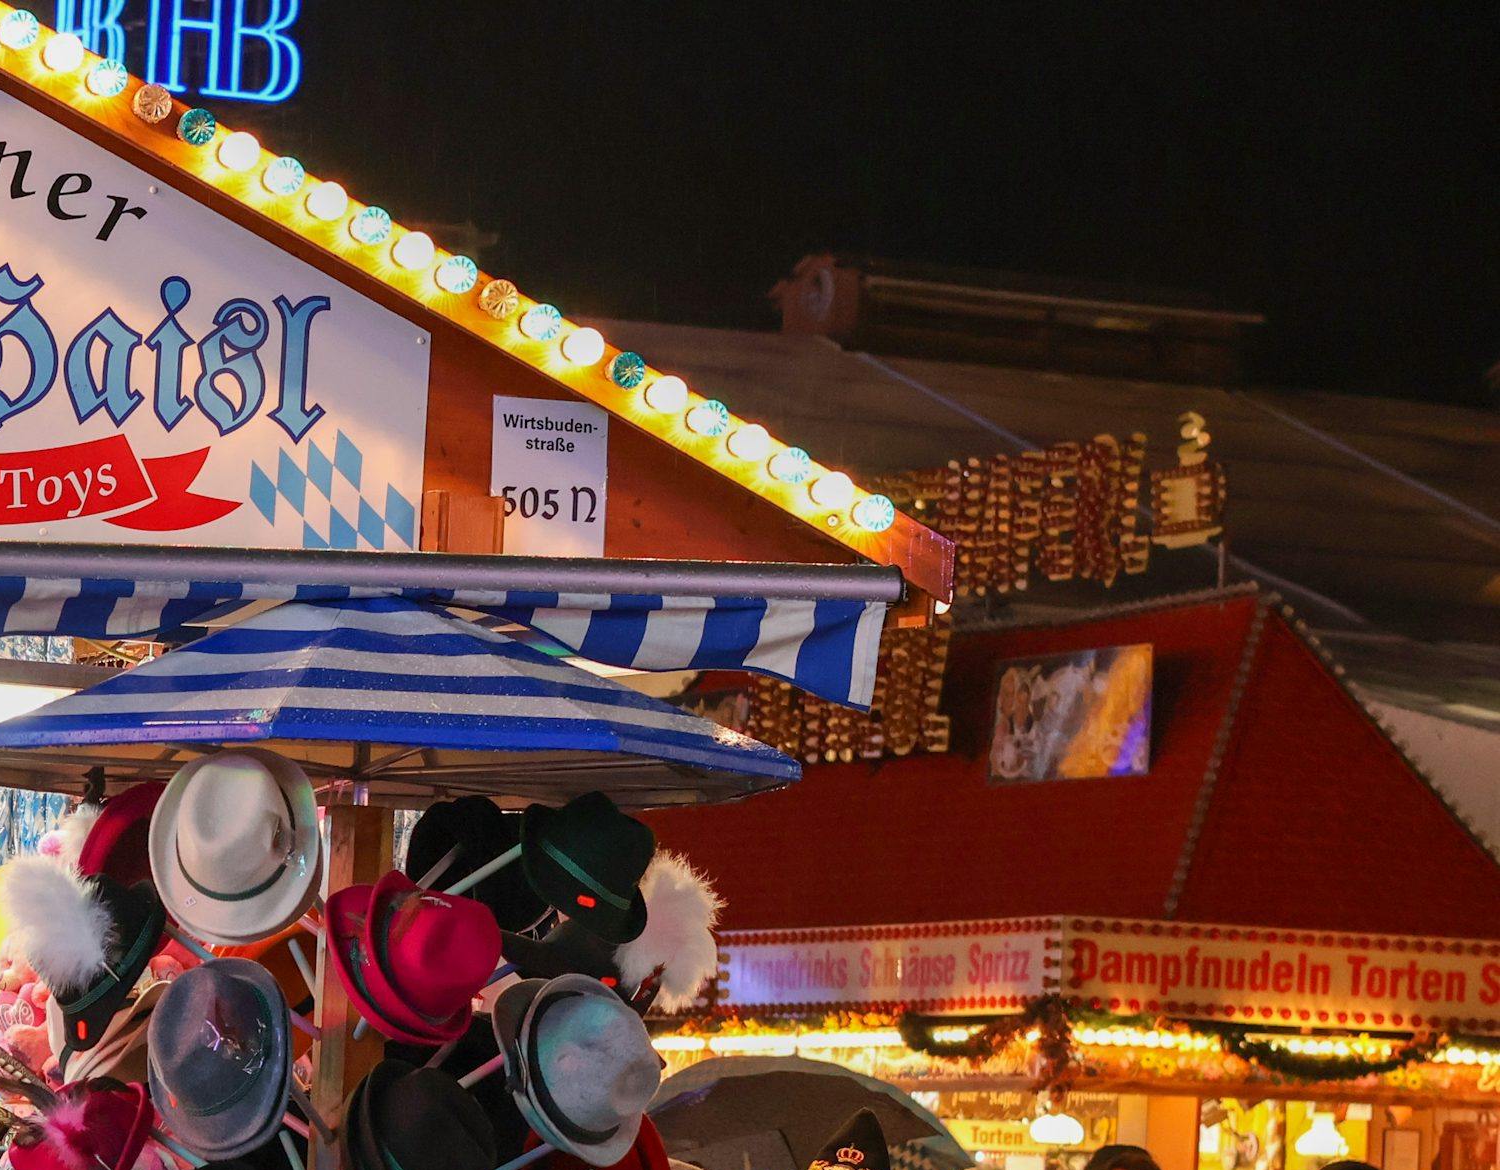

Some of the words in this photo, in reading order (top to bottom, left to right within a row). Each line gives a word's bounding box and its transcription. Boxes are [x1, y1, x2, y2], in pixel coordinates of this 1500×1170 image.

[503, 413, 598, 434] Wirtsbuden-
[525, 437, 575, 453] straße
[0, 460, 118, 519] Toys
[502, 485, 560, 521] 505
[967, 941, 1031, 993] Sprizz
[1073, 938, 1332, 996] Dampfnudeln
[1347, 954, 1467, 1004] Torten
[971, 1126, 1024, 1146] Torten
